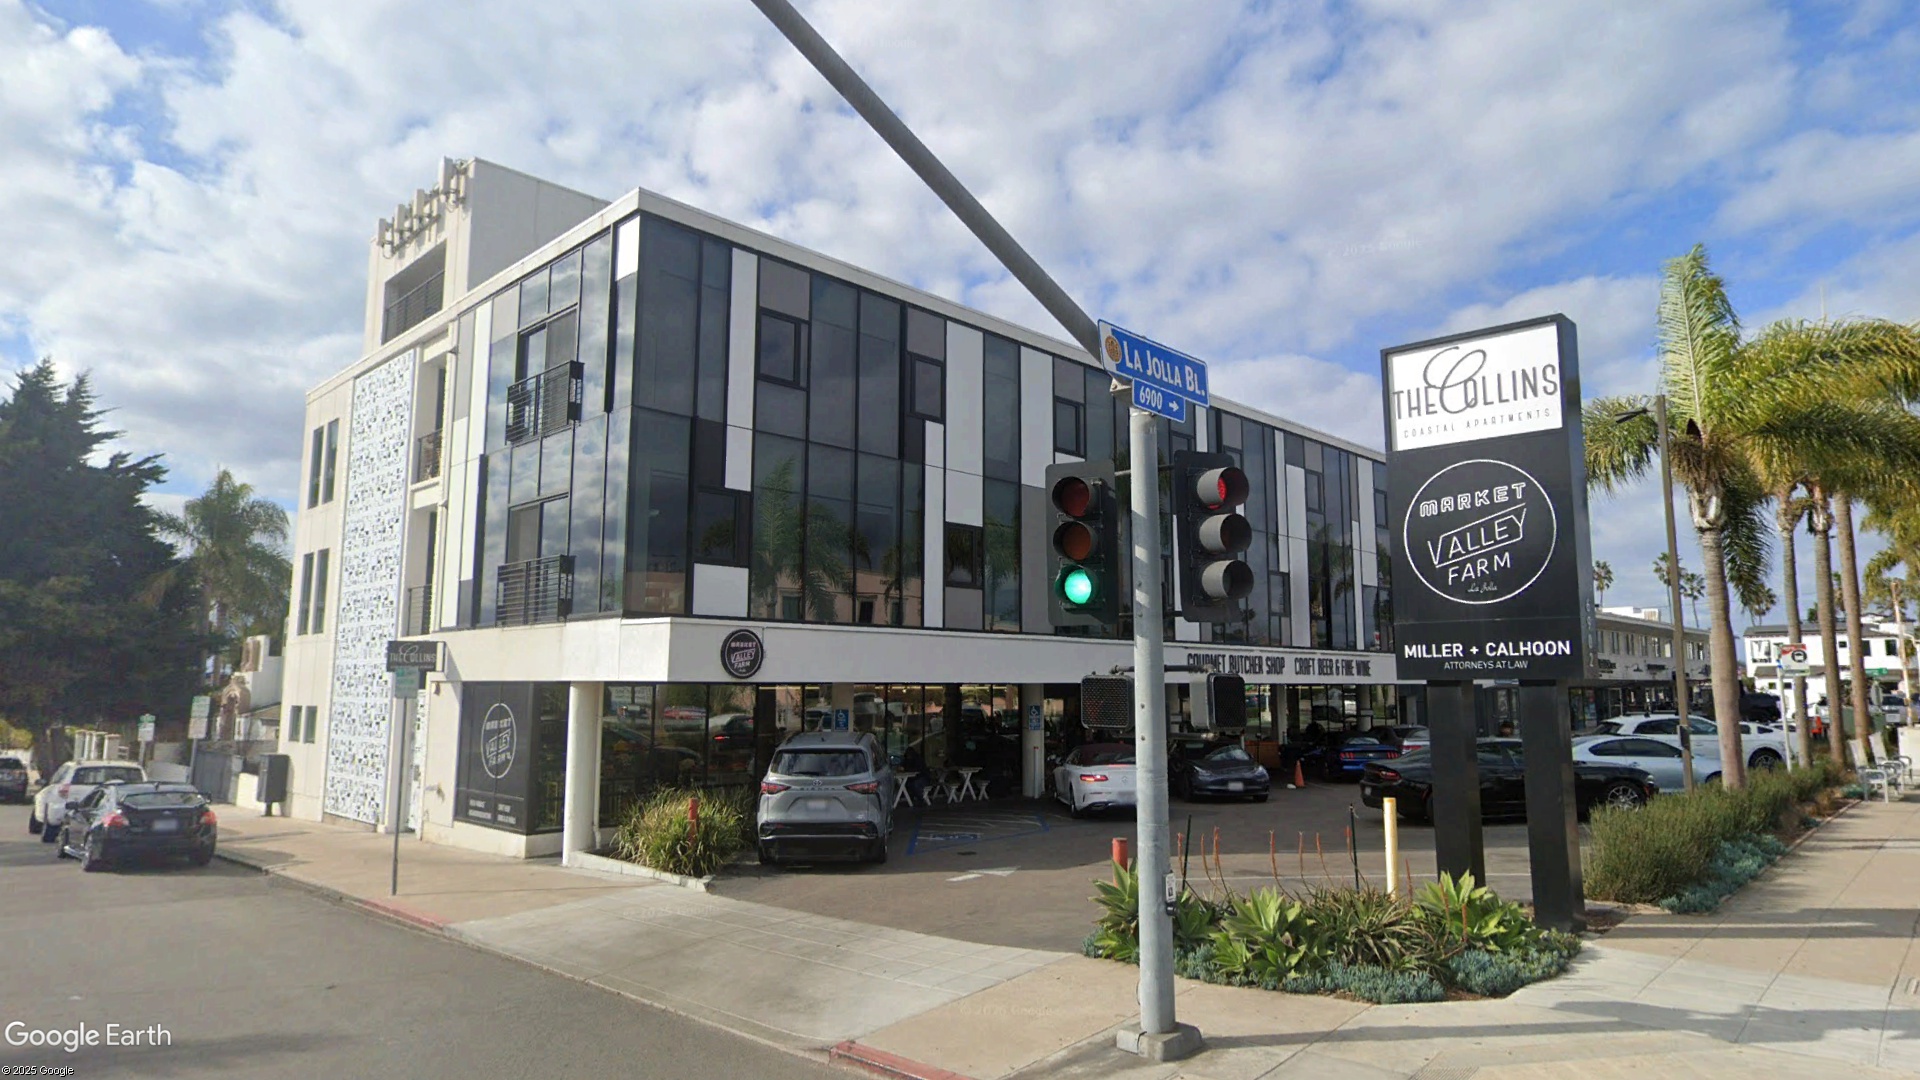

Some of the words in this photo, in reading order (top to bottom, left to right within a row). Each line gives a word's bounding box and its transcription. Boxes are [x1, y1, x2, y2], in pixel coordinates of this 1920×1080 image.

[1123, 340, 1143, 373] LA
[1146, 350, 1182, 388] JOLLA
[1393, 386, 1438, 420] THE
[1423, 346, 1558, 414] COLLINS
[1140, 385, 1163, 410] 6900
[1404, 422, 1456, 439] COASTAL
[1466, 408, 1551, 429] APARTMENTS
[1420, 482, 1526, 518] MARKET
[1427, 507, 1527, 566] VALLEY
[1448, 551, 1511, 586] FARM
[1404, 643, 1464, 659] MILLER
[1485, 640, 1572, 657] CALHOON
[734, 660, 751, 669] FARM
[1228, 655, 1263, 674] BUTCHER
[1265, 656, 1285, 675] SHOP
[1294, 657, 1315, 675] CRAFT
[1318, 658, 1334, 676] BEER
[1444, 661, 1494, 670] ATTORNEYS
[1495, 660, 1508, 669] AT
[1508, 660, 1529, 669] LAW
